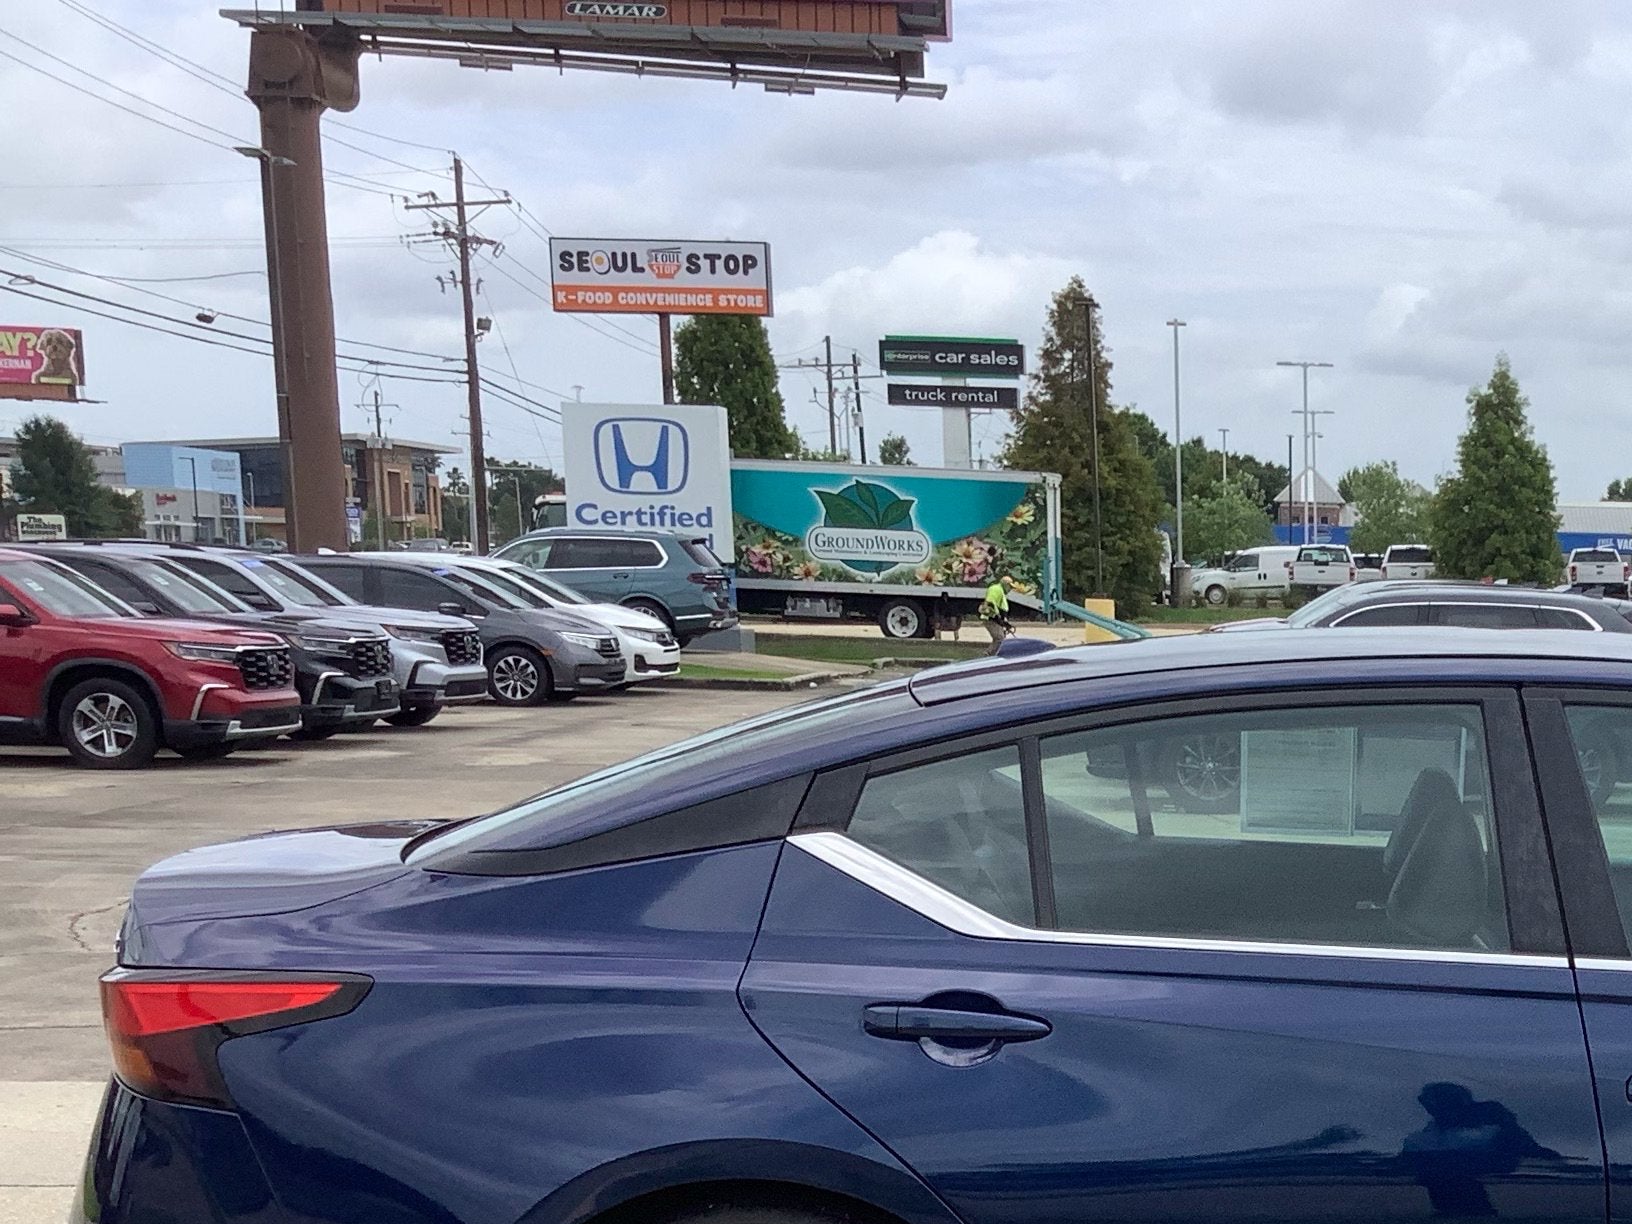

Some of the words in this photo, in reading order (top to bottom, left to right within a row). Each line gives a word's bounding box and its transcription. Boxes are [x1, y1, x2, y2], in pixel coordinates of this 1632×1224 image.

[573, 3, 657, 17] LAMAR
[559, 250, 645, 275] SEOUL
[685, 253, 758, 276] STOP
[556, 291, 613, 304] K-FOOD
[617, 293, 714, 306] CONVENIENCE
[718, 294, 764, 307] STORE
[934, 352, 966, 364] car
[970, 350, 1019, 366] sales
[904, 388, 946, 401] truck
[951, 390, 998, 403] rental
[575, 502, 713, 528] Certified
